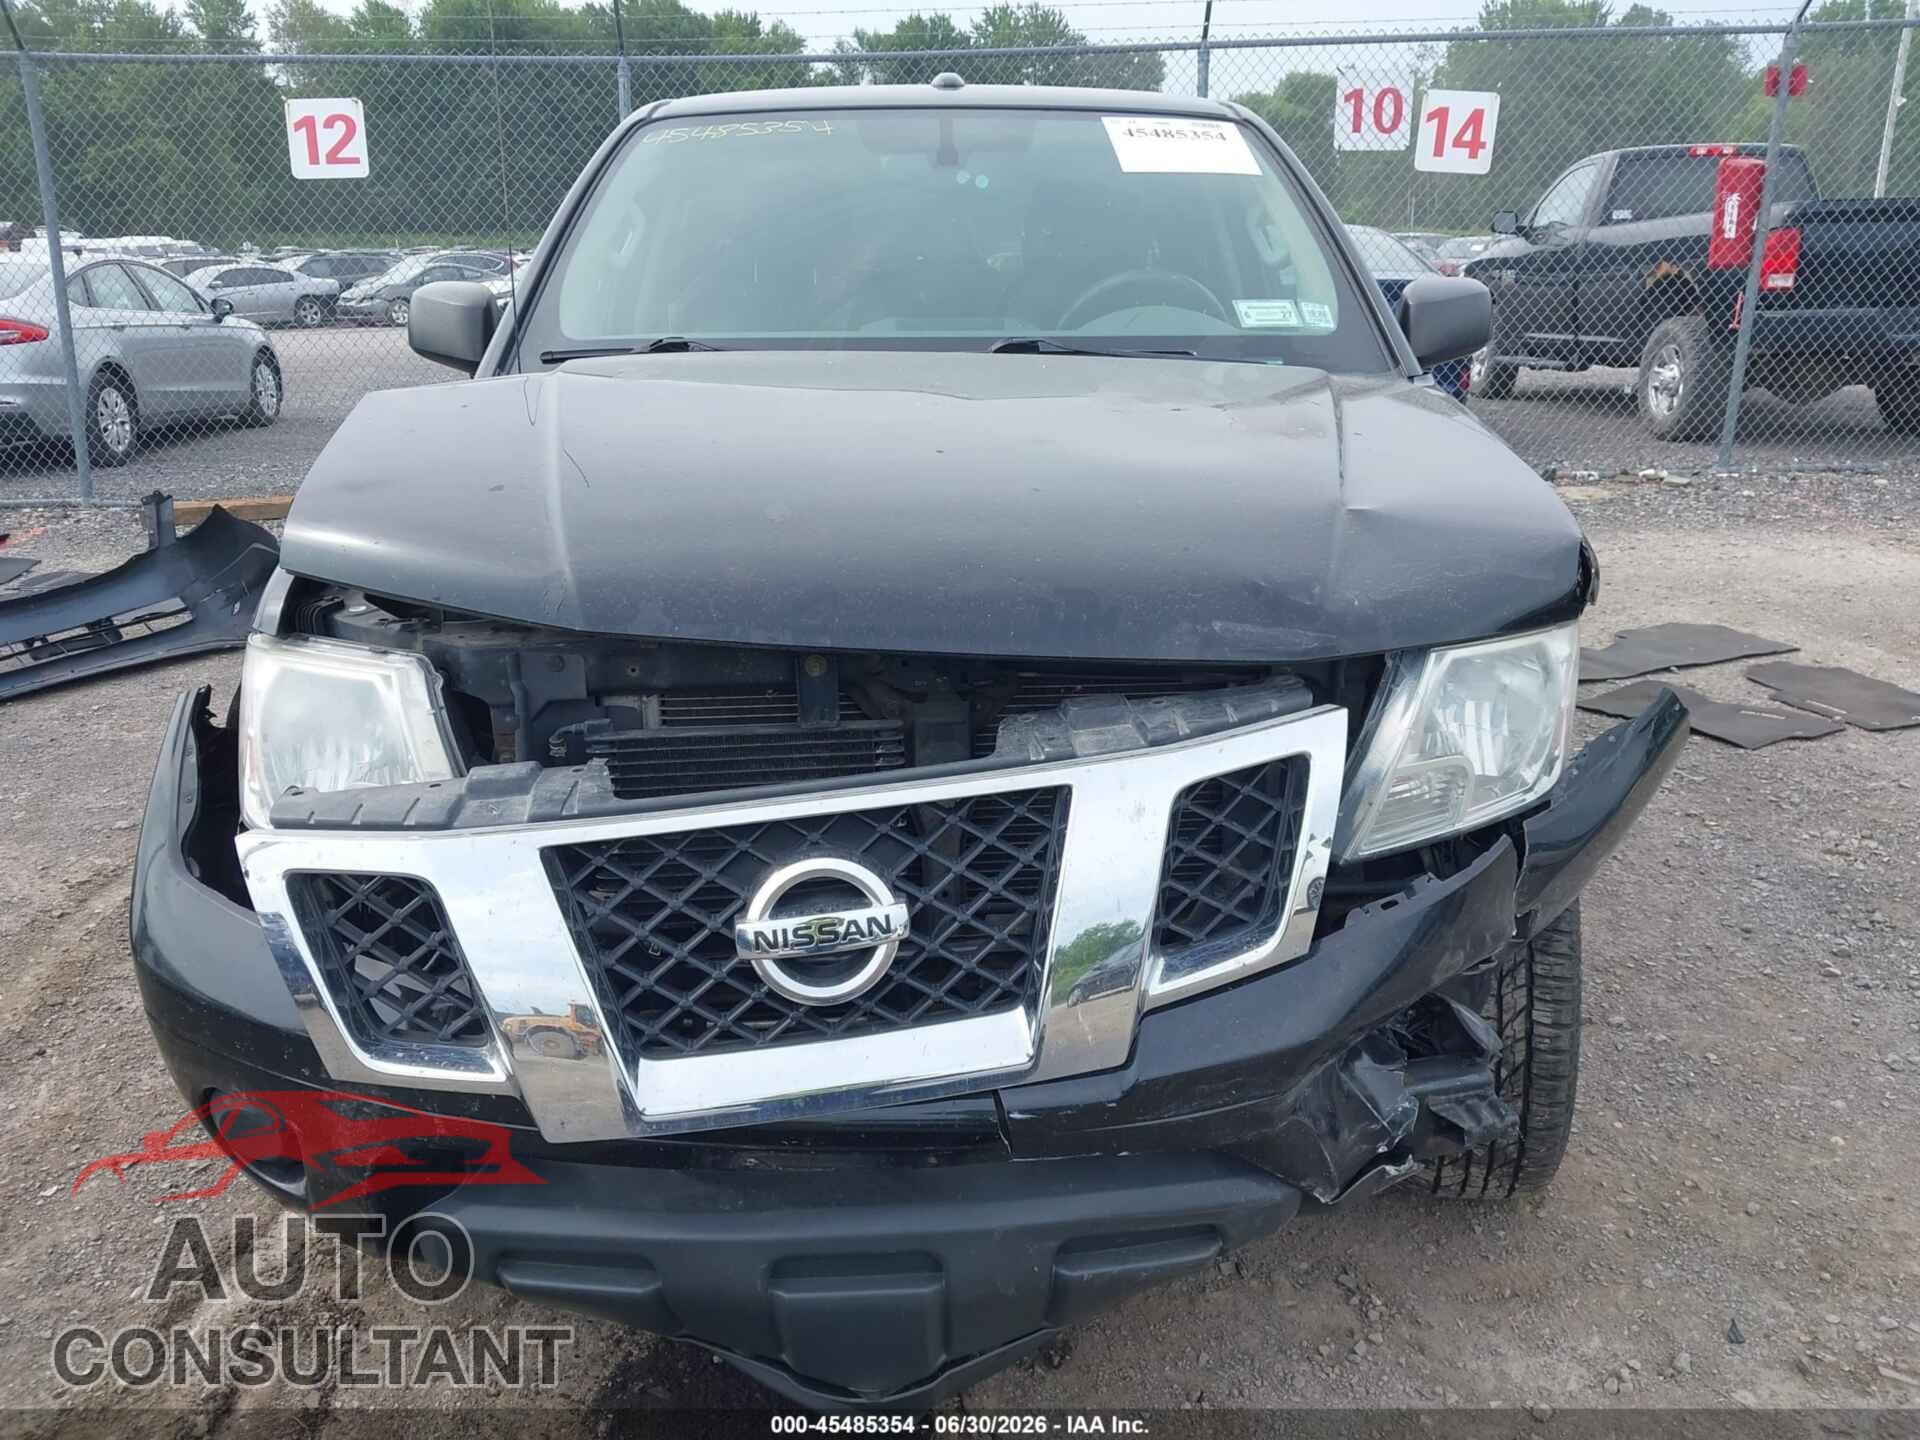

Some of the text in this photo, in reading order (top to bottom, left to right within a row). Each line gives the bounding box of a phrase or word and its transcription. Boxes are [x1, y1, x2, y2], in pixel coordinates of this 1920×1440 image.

[1345, 87, 1403, 134] 10
[1425, 106, 1487, 160] 14
[292, 113, 361, 166] 12
[1122, 127, 1227, 142] 45485354
[753, 913, 892, 951] NISSAN
